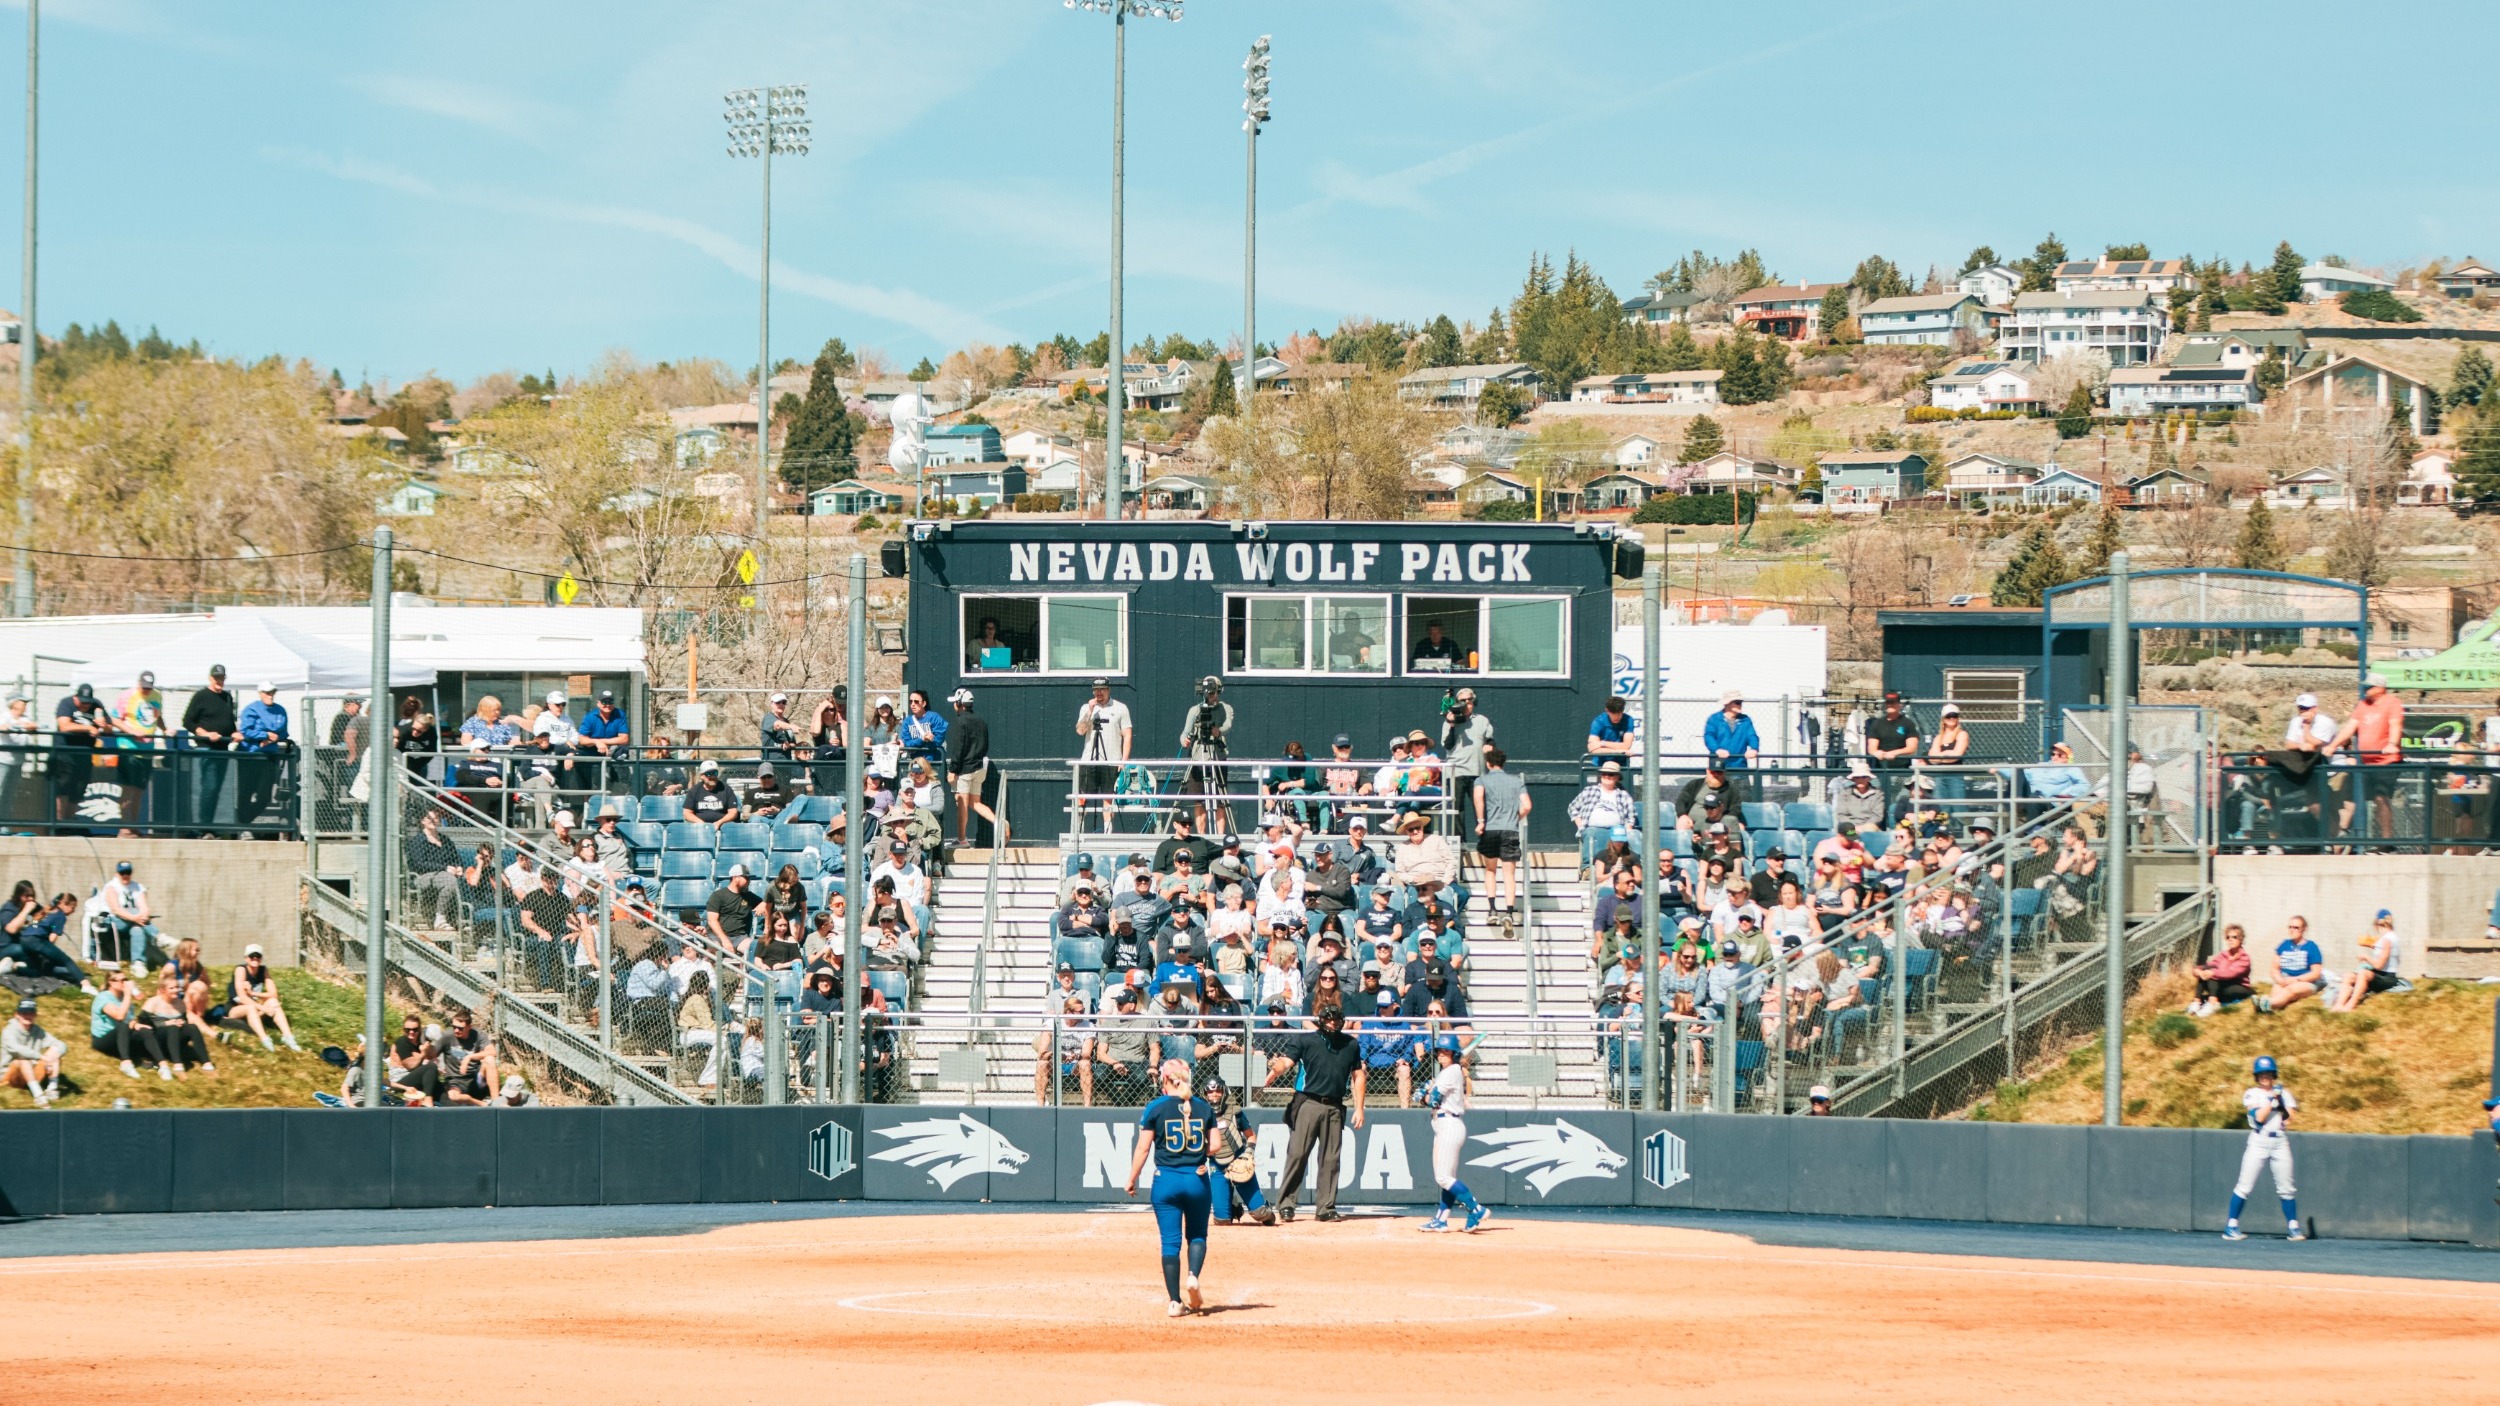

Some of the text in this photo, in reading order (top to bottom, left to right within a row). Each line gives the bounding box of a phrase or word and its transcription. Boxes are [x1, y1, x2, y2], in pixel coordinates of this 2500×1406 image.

[1009, 542, 1532, 582] NEVADA WOLF PACK
[2403, 669, 2486, 682] RENEWAL
[1164, 1118, 1204, 1153] 55
[1083, 1121, 1413, 1190] NADA
